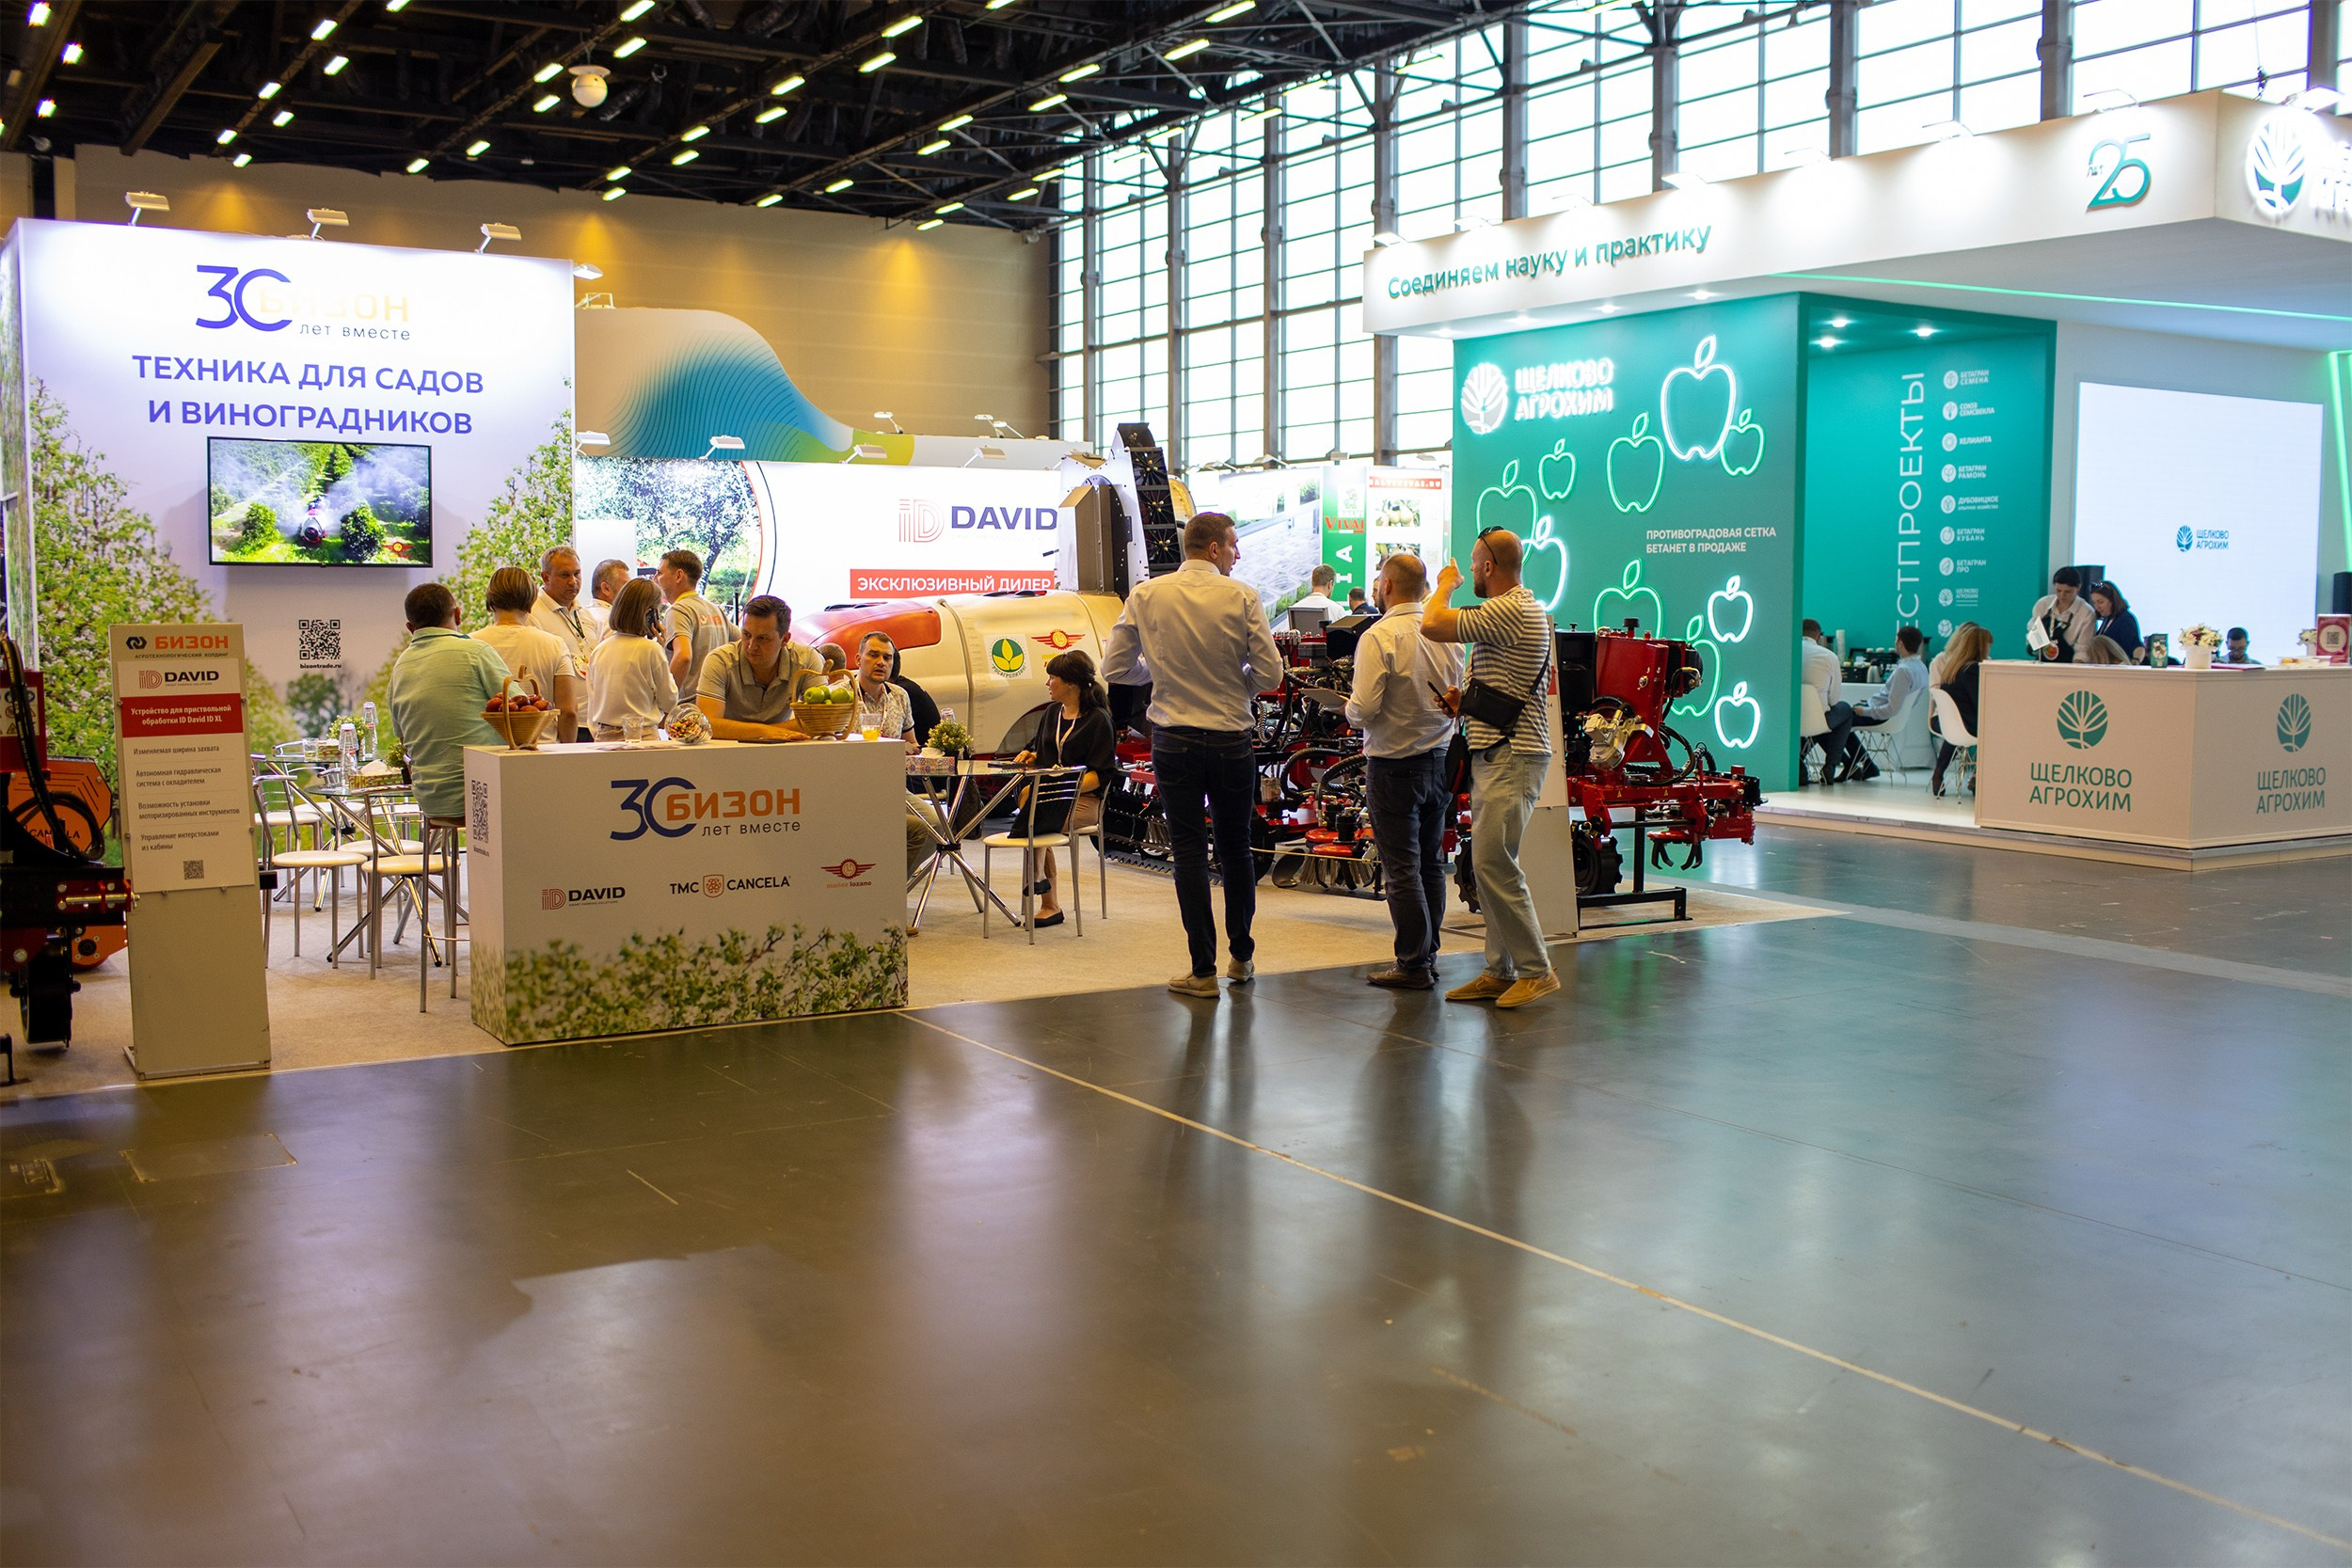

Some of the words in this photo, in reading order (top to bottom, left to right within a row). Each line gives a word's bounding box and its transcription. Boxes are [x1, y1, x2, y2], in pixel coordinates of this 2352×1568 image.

[1388, 262, 1499, 298] Соединяем
[1506, 248, 1567, 279] науку
[1575, 247, 1587, 266] и
[1597, 226, 1712, 265] практику
[300, 324, 332, 336] лет
[342, 325, 410, 341] вместе
[133, 355, 291, 385] ТЕХНИКА
[298, 363, 366, 390] ДЛЯ
[375, 368, 484, 396] САДОВ
[1515, 357, 1614, 393] ЩЕЛКОВО
[1514, 387, 1613, 420] АГРОХИМ
[149, 401, 170, 423] И
[182, 402, 472, 435] ВИНОГРАДНИКОВ
[951, 506, 1057, 531] DAVID
[1646, 528, 1742, 540] ПРОТИВОГРАДОВАЯ
[1744, 527, 1776, 537] СЕТКА
[2197, 530, 2229, 539] ЩЕЛКОВО
[1646, 543, 1687, 553] БЕТАНЕТ
[1689, 543, 1695, 552] В
[1697, 542, 1746, 554] ПРОДАЖЕ
[2197, 541, 2229, 549] АГРОХИМ
[857, 575, 995, 592] ЭКСКЛЮЗИВНЫЙ
[999, 578, 1052, 592] ДИЛЕР
[155, 635, 229, 649] БИЗОН
[165, 671, 219, 682] DAVID
[131, 707, 169, 717] Устройство
[184, 705, 231, 715] приствольной
[142, 718, 178, 726] обработки
[173, 768, 222, 776] гидравлическая
[2030, 762, 2132, 788] ЩЕЛКОВО
[2258, 767, 2327, 792] ЩЕЛКОВО
[181, 800, 211, 809] установки
[666, 788, 800, 821] БИЗОН
[2029, 785, 2131, 812] АГРОХИМ
[2256, 789, 2325, 815] АГРОХИМ
[199, 808, 240, 816] инструментов
[30, 829, 80, 839] CANLA
[702, 825, 731, 837] лет
[740, 821, 801, 834] вместе
[568, 886, 626, 901] DAVID
[670, 881, 699, 895] TMC
[727, 876, 790, 891] CANCELA
